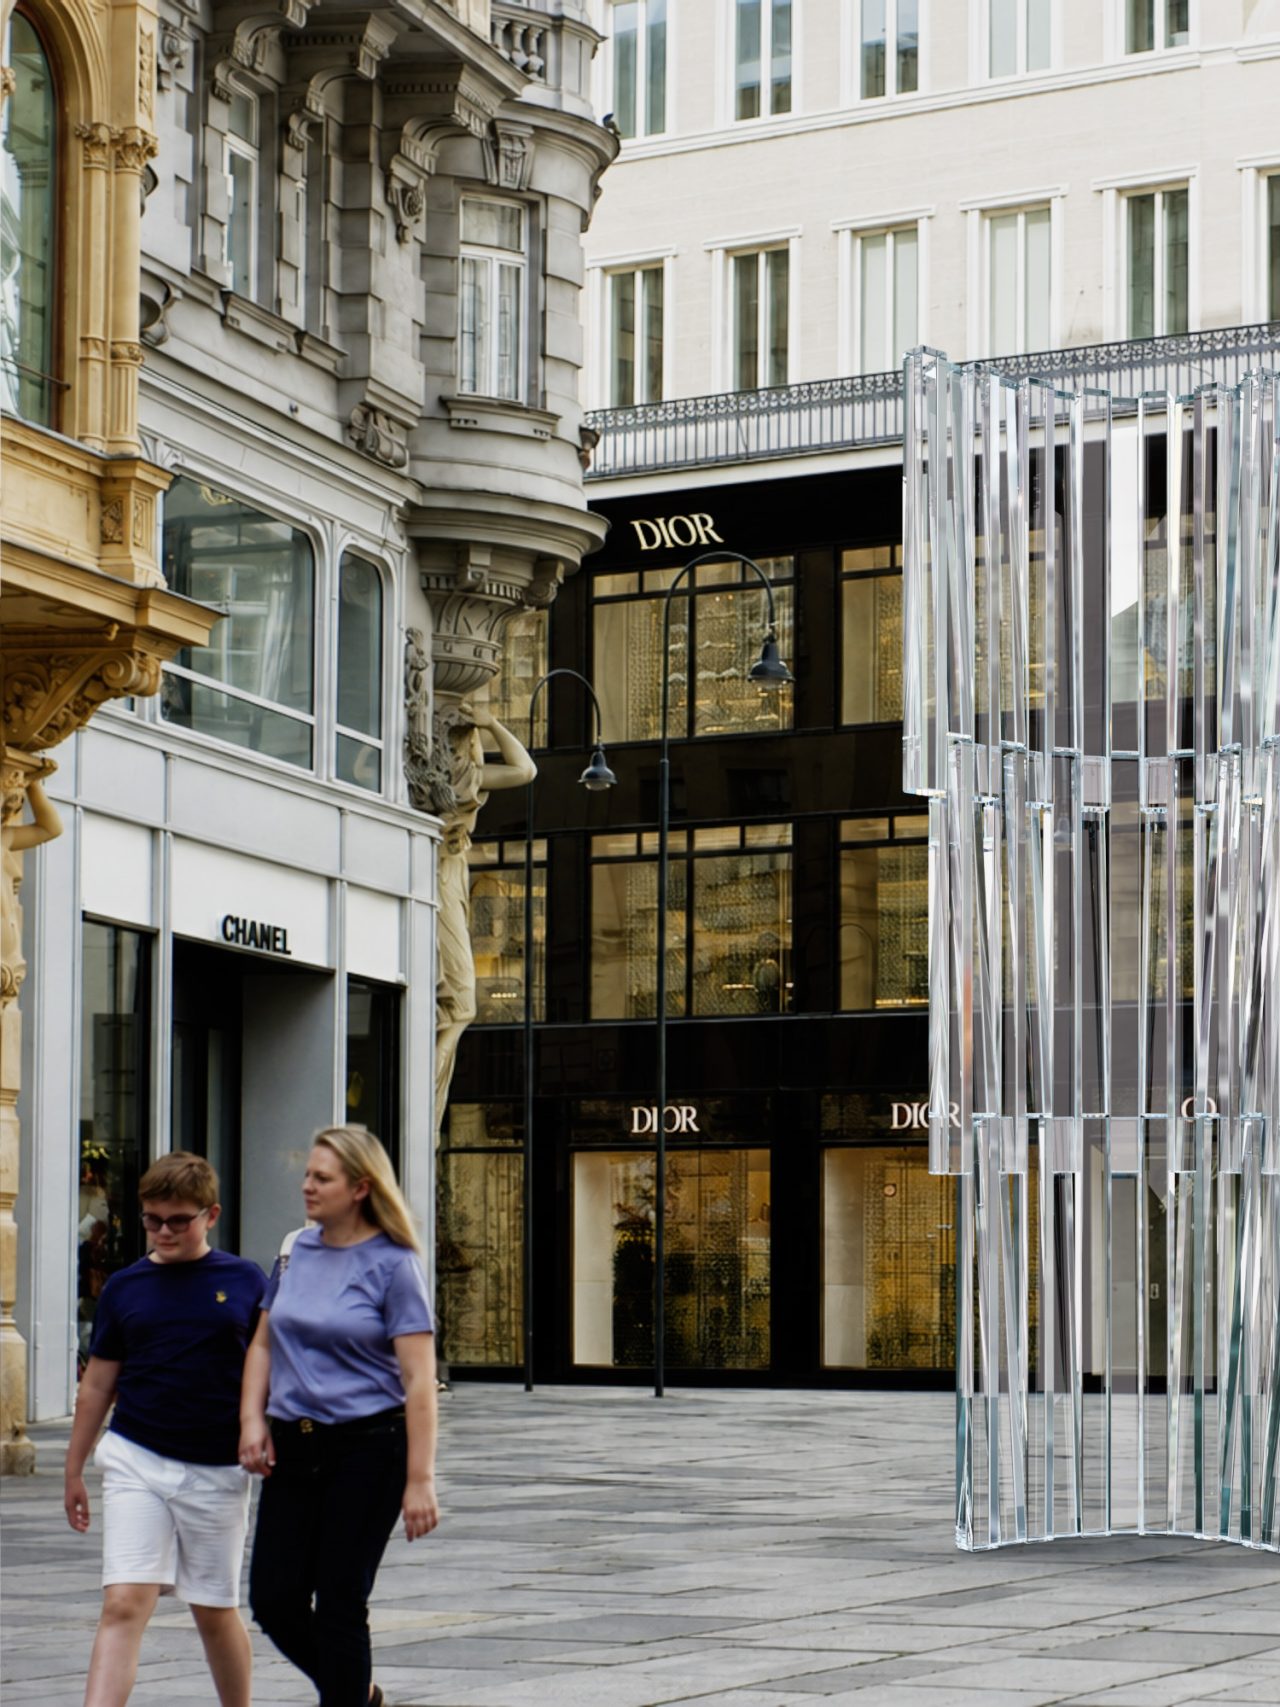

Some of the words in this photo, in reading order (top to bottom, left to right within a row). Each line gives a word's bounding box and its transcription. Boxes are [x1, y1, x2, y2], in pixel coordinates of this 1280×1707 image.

[631, 513, 724, 550] DIOR
[222, 914, 292, 955] CHANEL
[631, 1105, 700, 1133] DIOR
